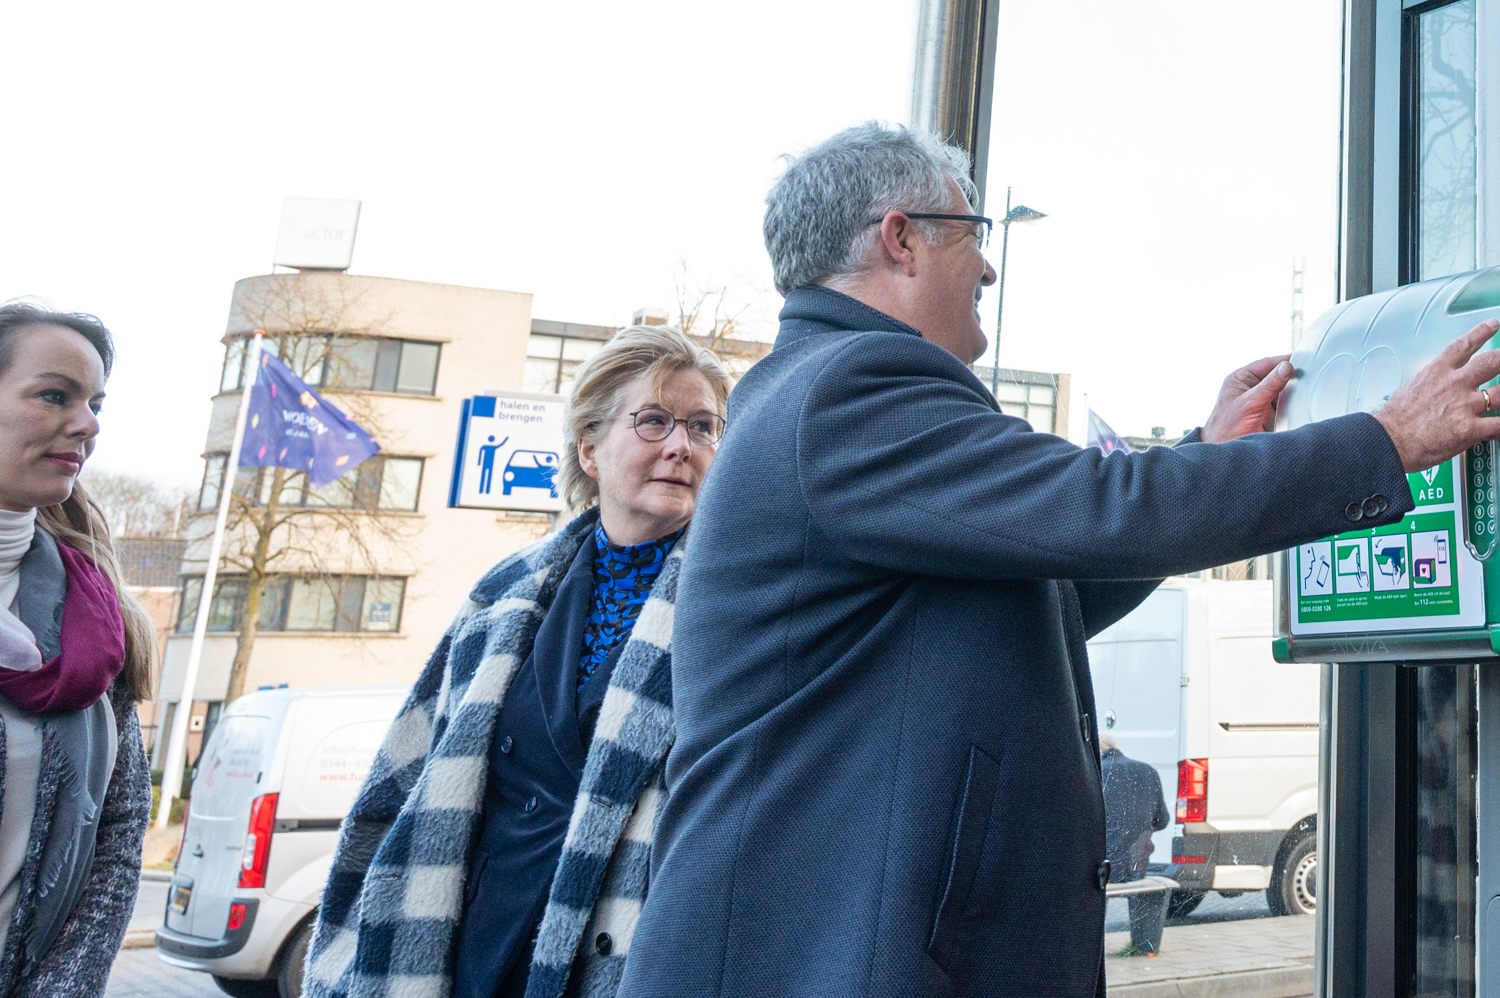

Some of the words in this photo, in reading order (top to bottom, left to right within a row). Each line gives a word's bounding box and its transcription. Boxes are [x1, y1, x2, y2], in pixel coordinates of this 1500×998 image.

[500, 400, 529, 411] halen
[532, 404, 546, 412] en
[498, 411, 543, 424] brengen
[1418, 487, 1444, 501] AED
[1410, 520, 1416, 530] 4
